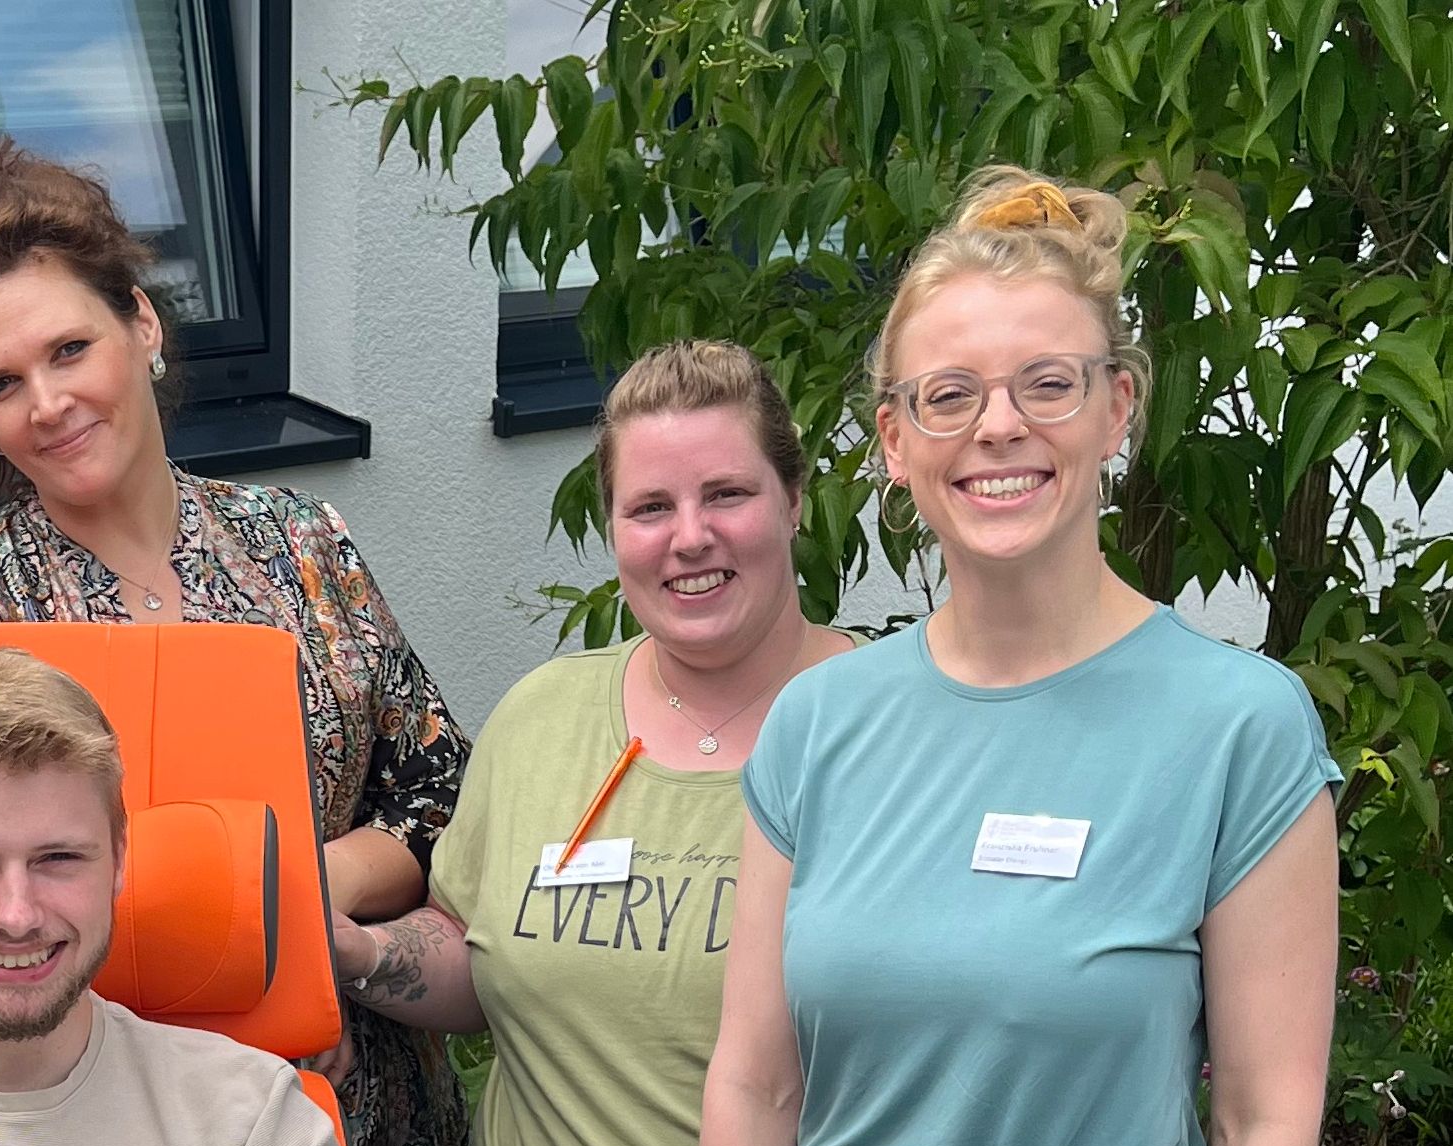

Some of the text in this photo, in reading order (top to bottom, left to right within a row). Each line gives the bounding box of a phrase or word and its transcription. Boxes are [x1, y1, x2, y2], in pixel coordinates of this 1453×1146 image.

[631, 841, 740, 869] oose happ
[512, 865, 738, 953] EVERY D
